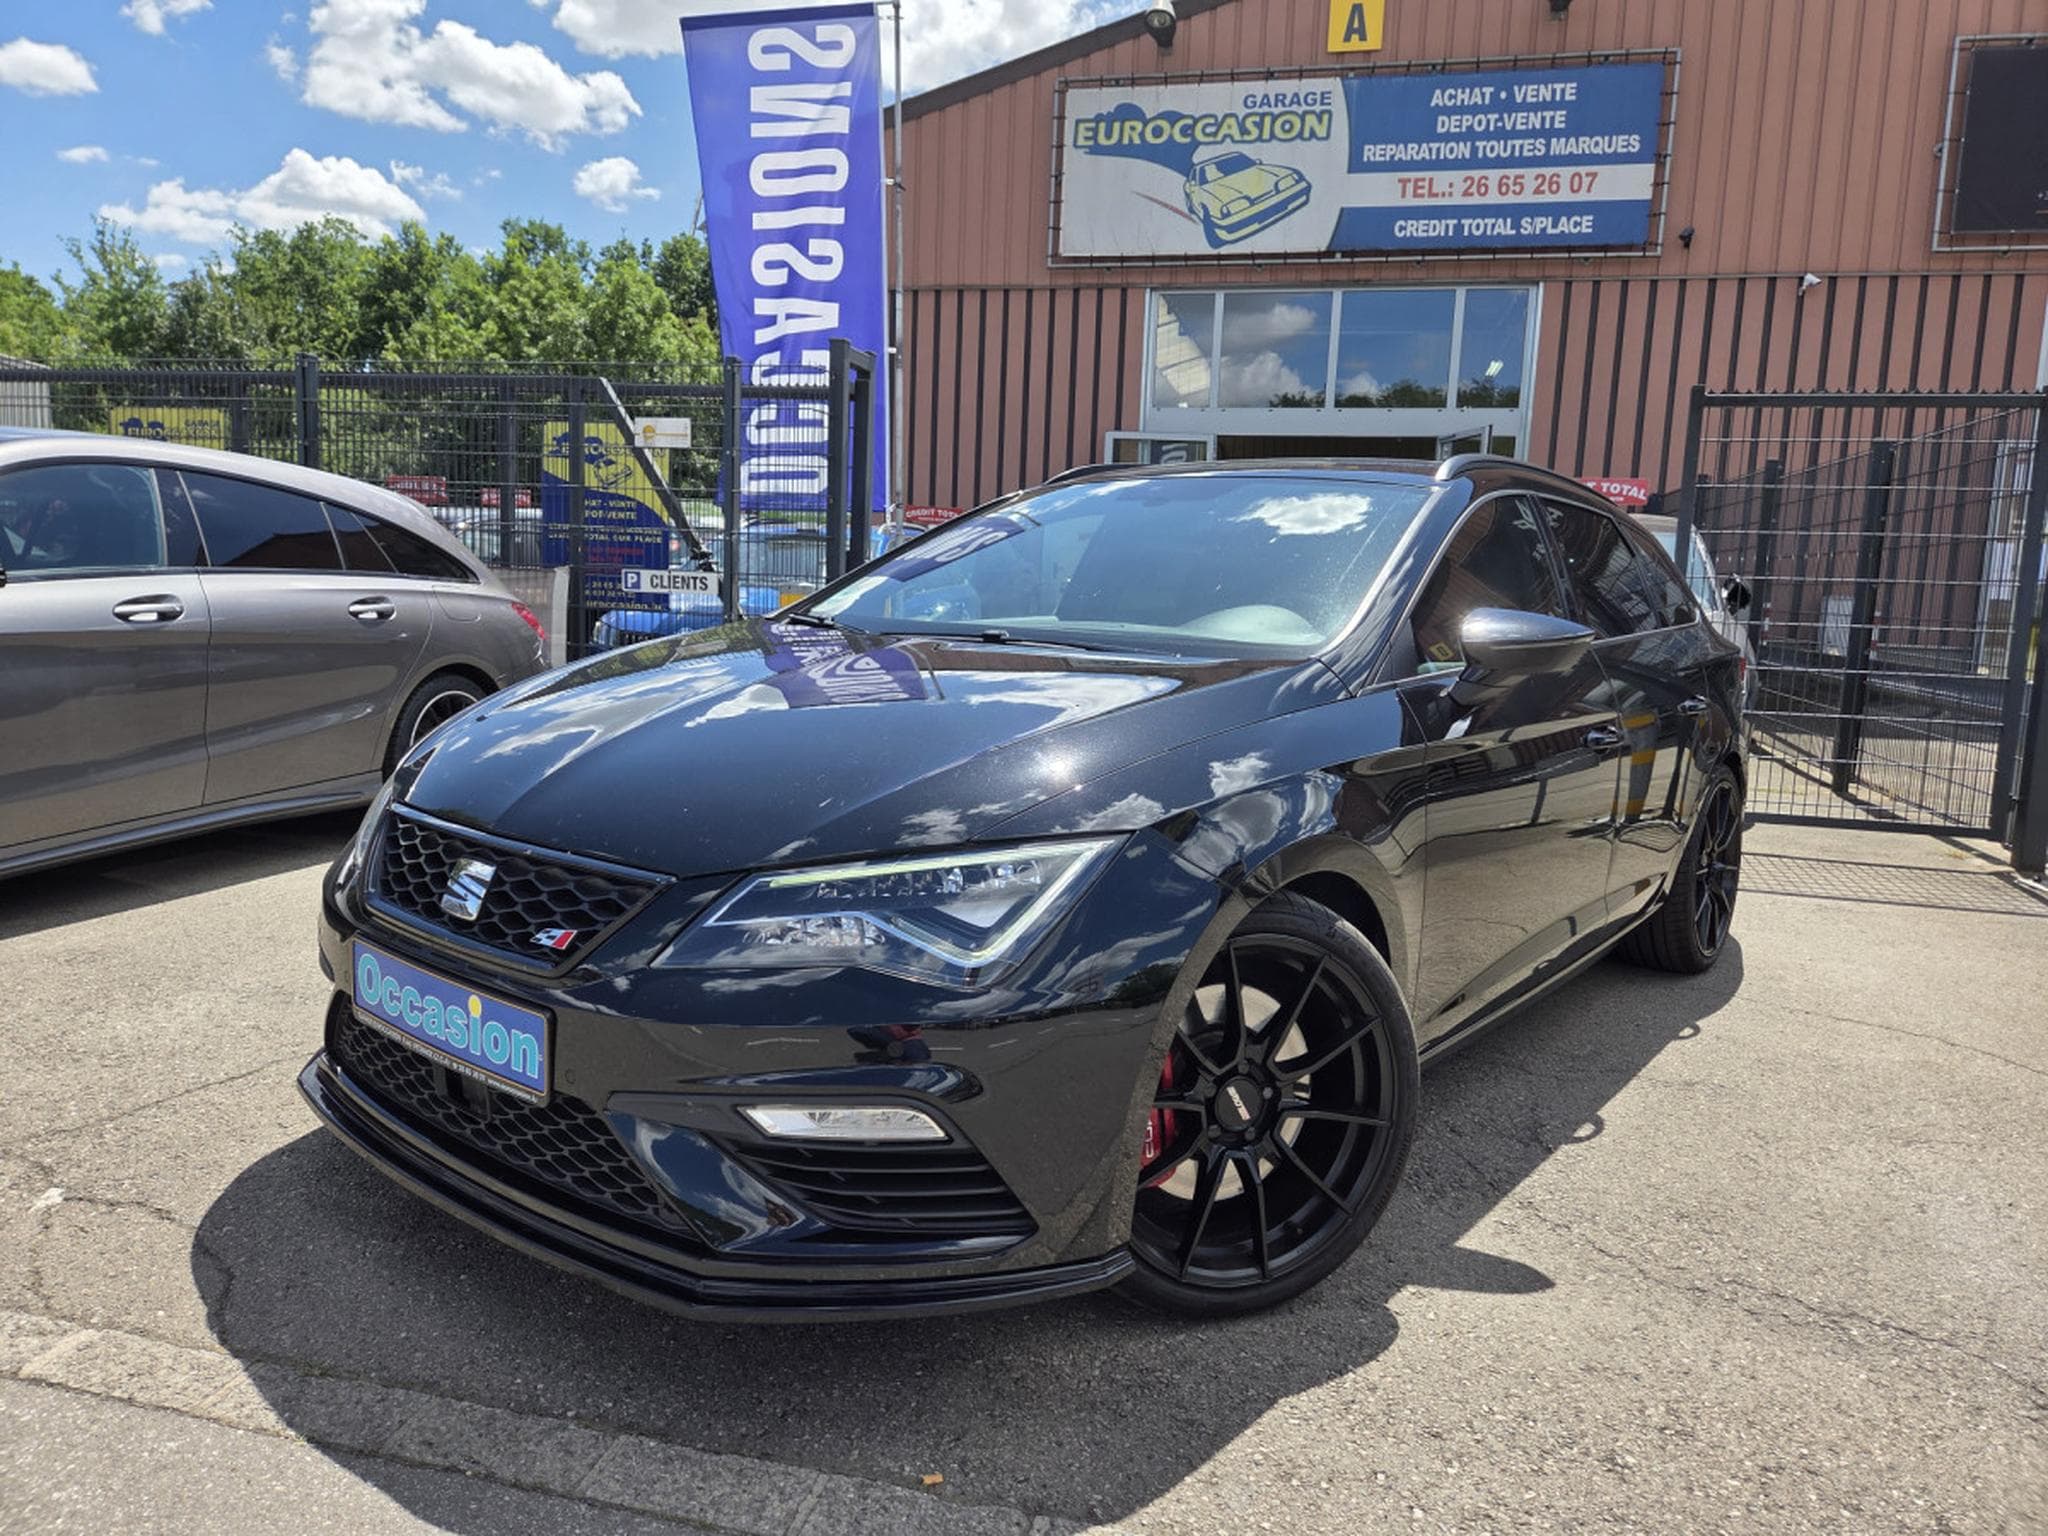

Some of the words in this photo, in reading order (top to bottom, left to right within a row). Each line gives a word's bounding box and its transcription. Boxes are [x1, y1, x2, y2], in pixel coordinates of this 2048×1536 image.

[1343, 3, 1367, 42] A
[1243, 91, 1332, 109] GARAGE
[1430, 87, 1494, 107] ACHAT
[1514, 82, 1577, 103] VENTE
[1075, 109, 1332, 148] EUROCCASION
[1436, 110, 1567, 133] DEPOT-VENTE
[1363, 142, 1470, 162] REPARATION
[1475, 139, 1546, 159] TOUTES
[1550, 135, 1640, 156] MARQUES
[1397, 177, 1453, 199] TEL.:
[1461, 176, 1489, 197] 26
[1497, 174, 1525, 196] 65
[1532, 173, 1561, 195] 26
[1569, 171, 1599, 194] 07
[1394, 218, 1457, 239] CREDIT
[1461, 217, 1516, 237] TOTAL
[1520, 215, 1593, 235] S/PLACE
[1600, 482, 1647, 500] TOTAL
[650, 574, 709, 591] CLIENTS
[358, 954, 539, 1079] Occasion
